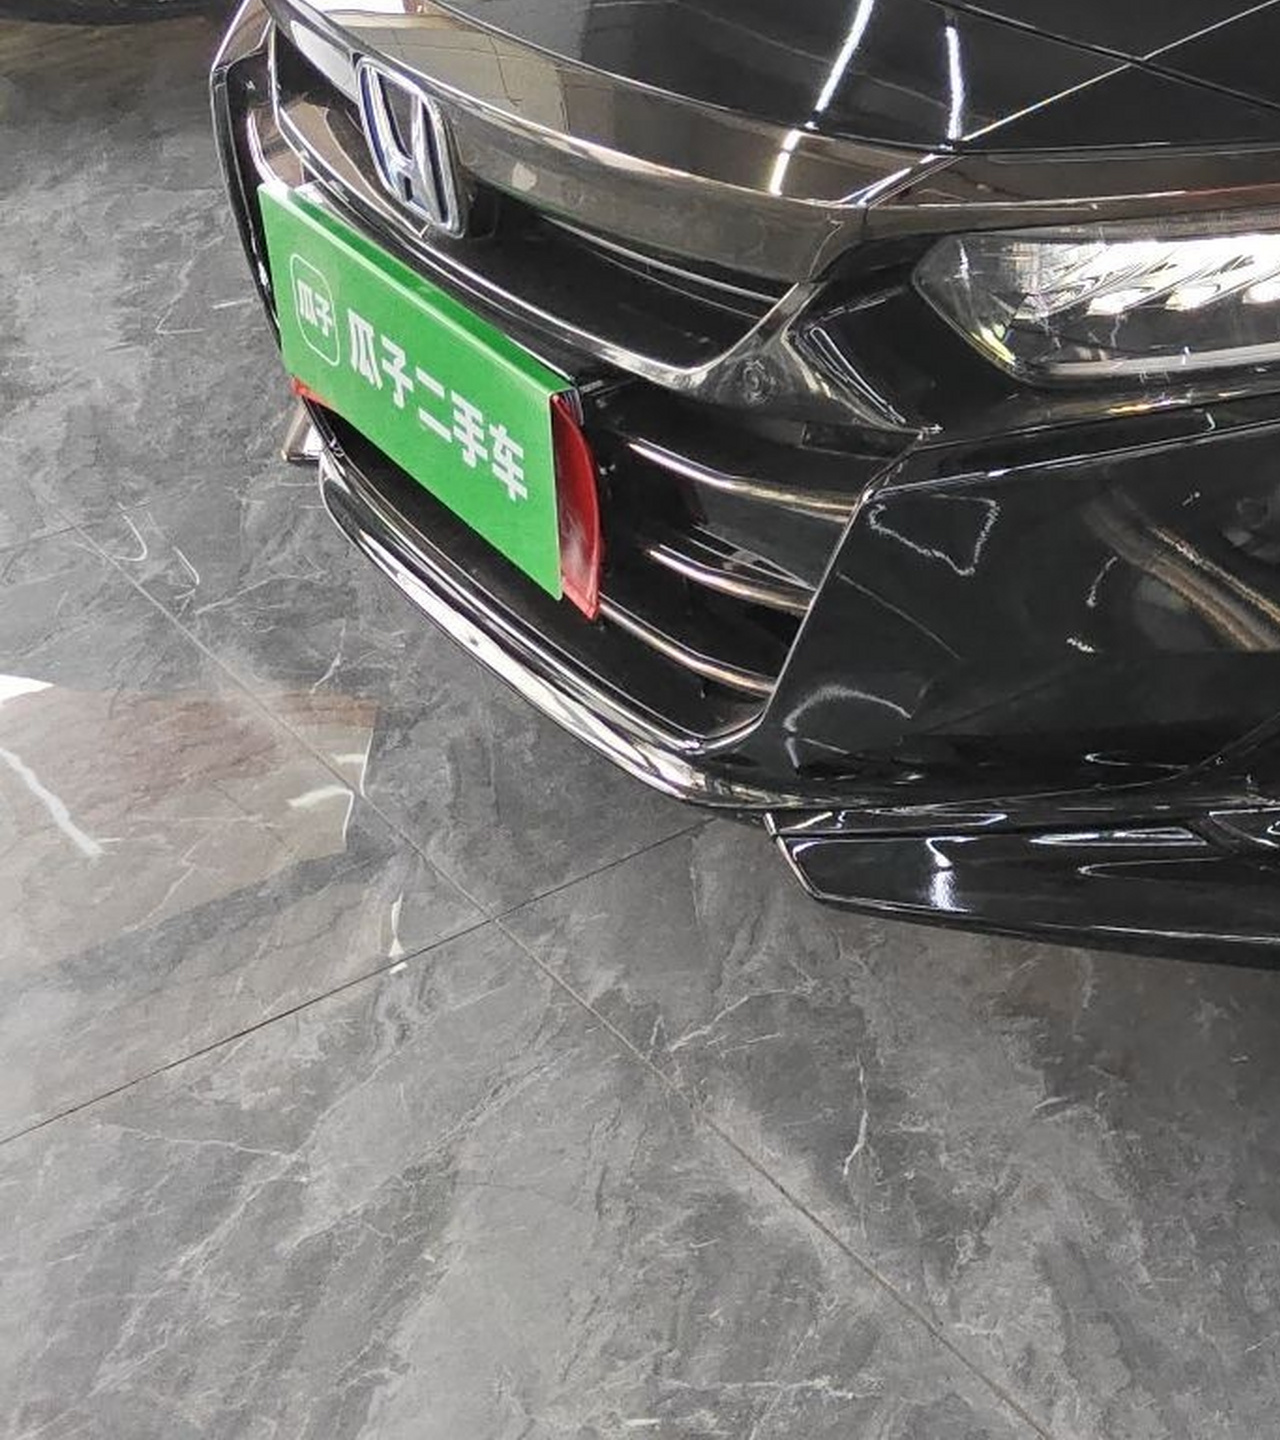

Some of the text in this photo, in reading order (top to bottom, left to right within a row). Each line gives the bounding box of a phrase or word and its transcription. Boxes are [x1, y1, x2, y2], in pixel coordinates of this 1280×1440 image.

[297, 279, 332, 336] 瓜子
[348, 308, 528, 501] 瓜子二手车
